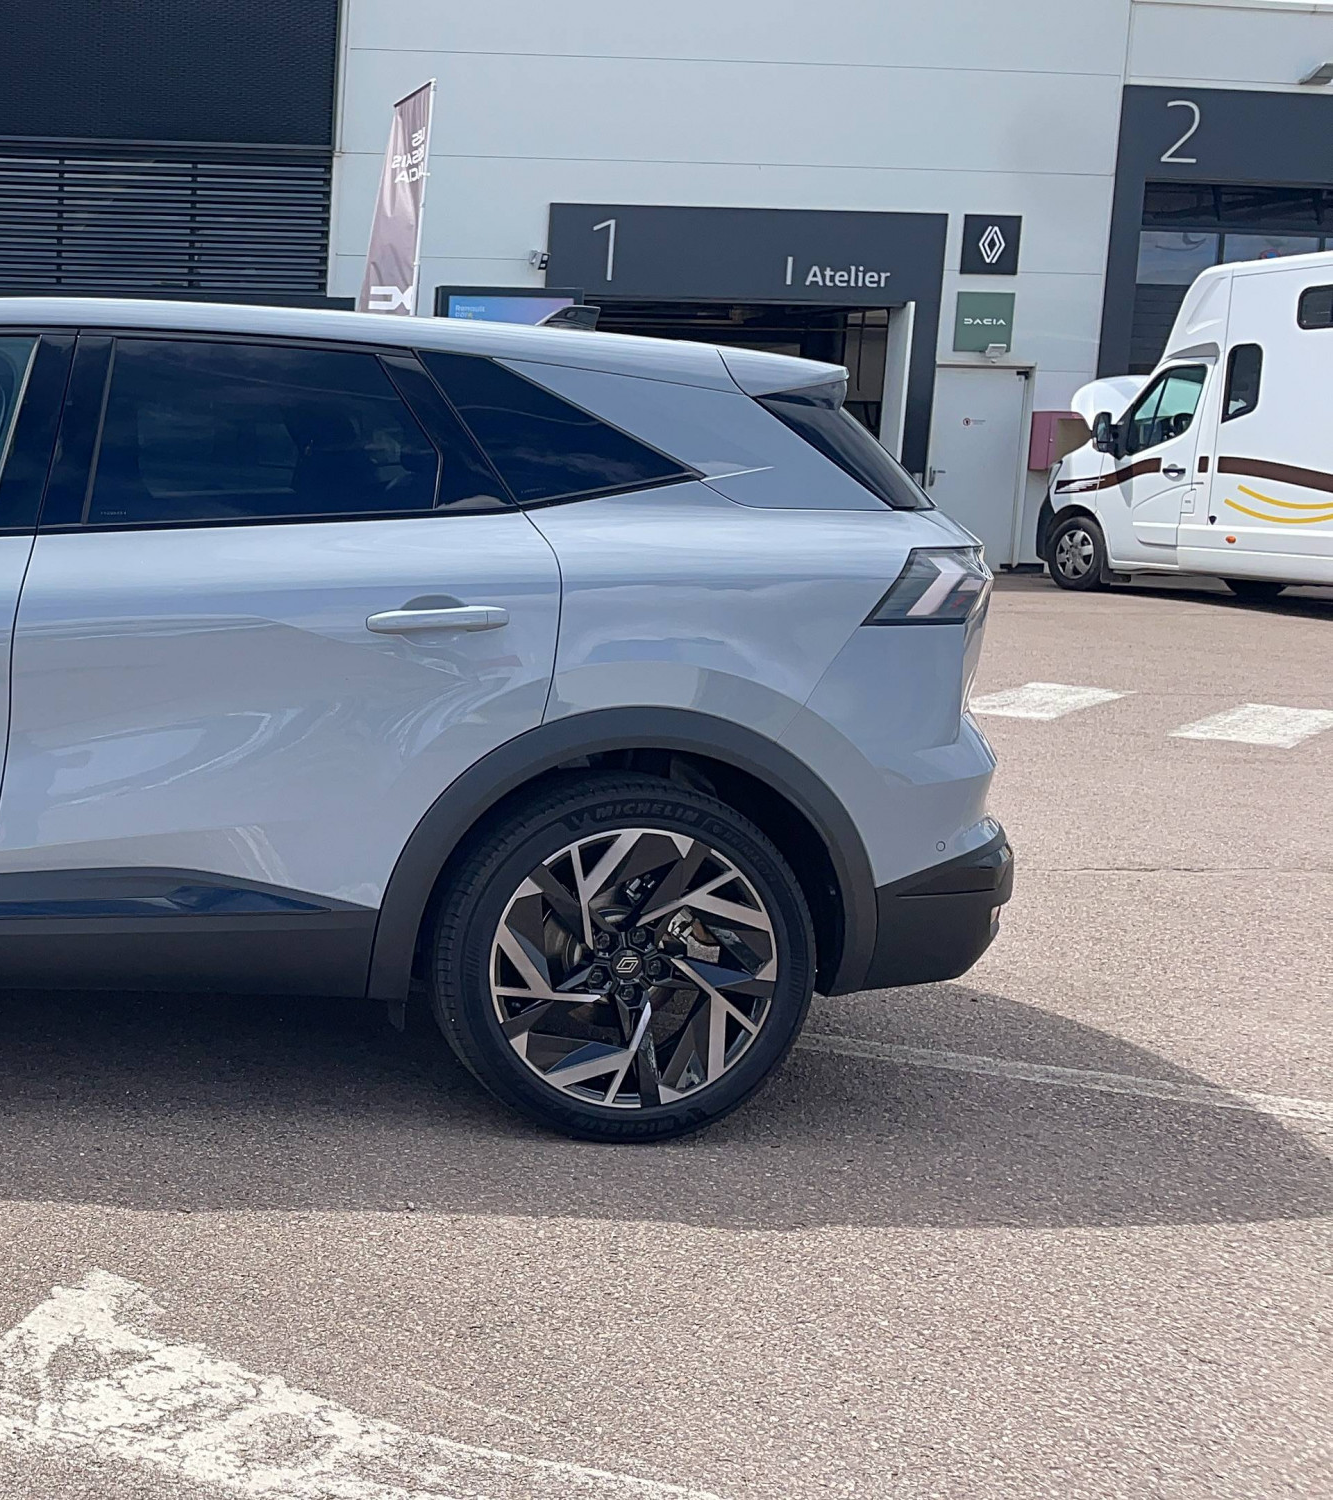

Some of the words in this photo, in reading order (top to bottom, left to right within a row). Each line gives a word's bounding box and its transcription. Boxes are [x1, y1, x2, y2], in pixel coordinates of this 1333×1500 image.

[1160, 99, 1201, 163] 2
[592, 218, 616, 281] 1
[804, 264, 891, 288] Atelier
[963, 317, 1007, 326] DACIA
[596, 802, 700, 822] MICHELIN
